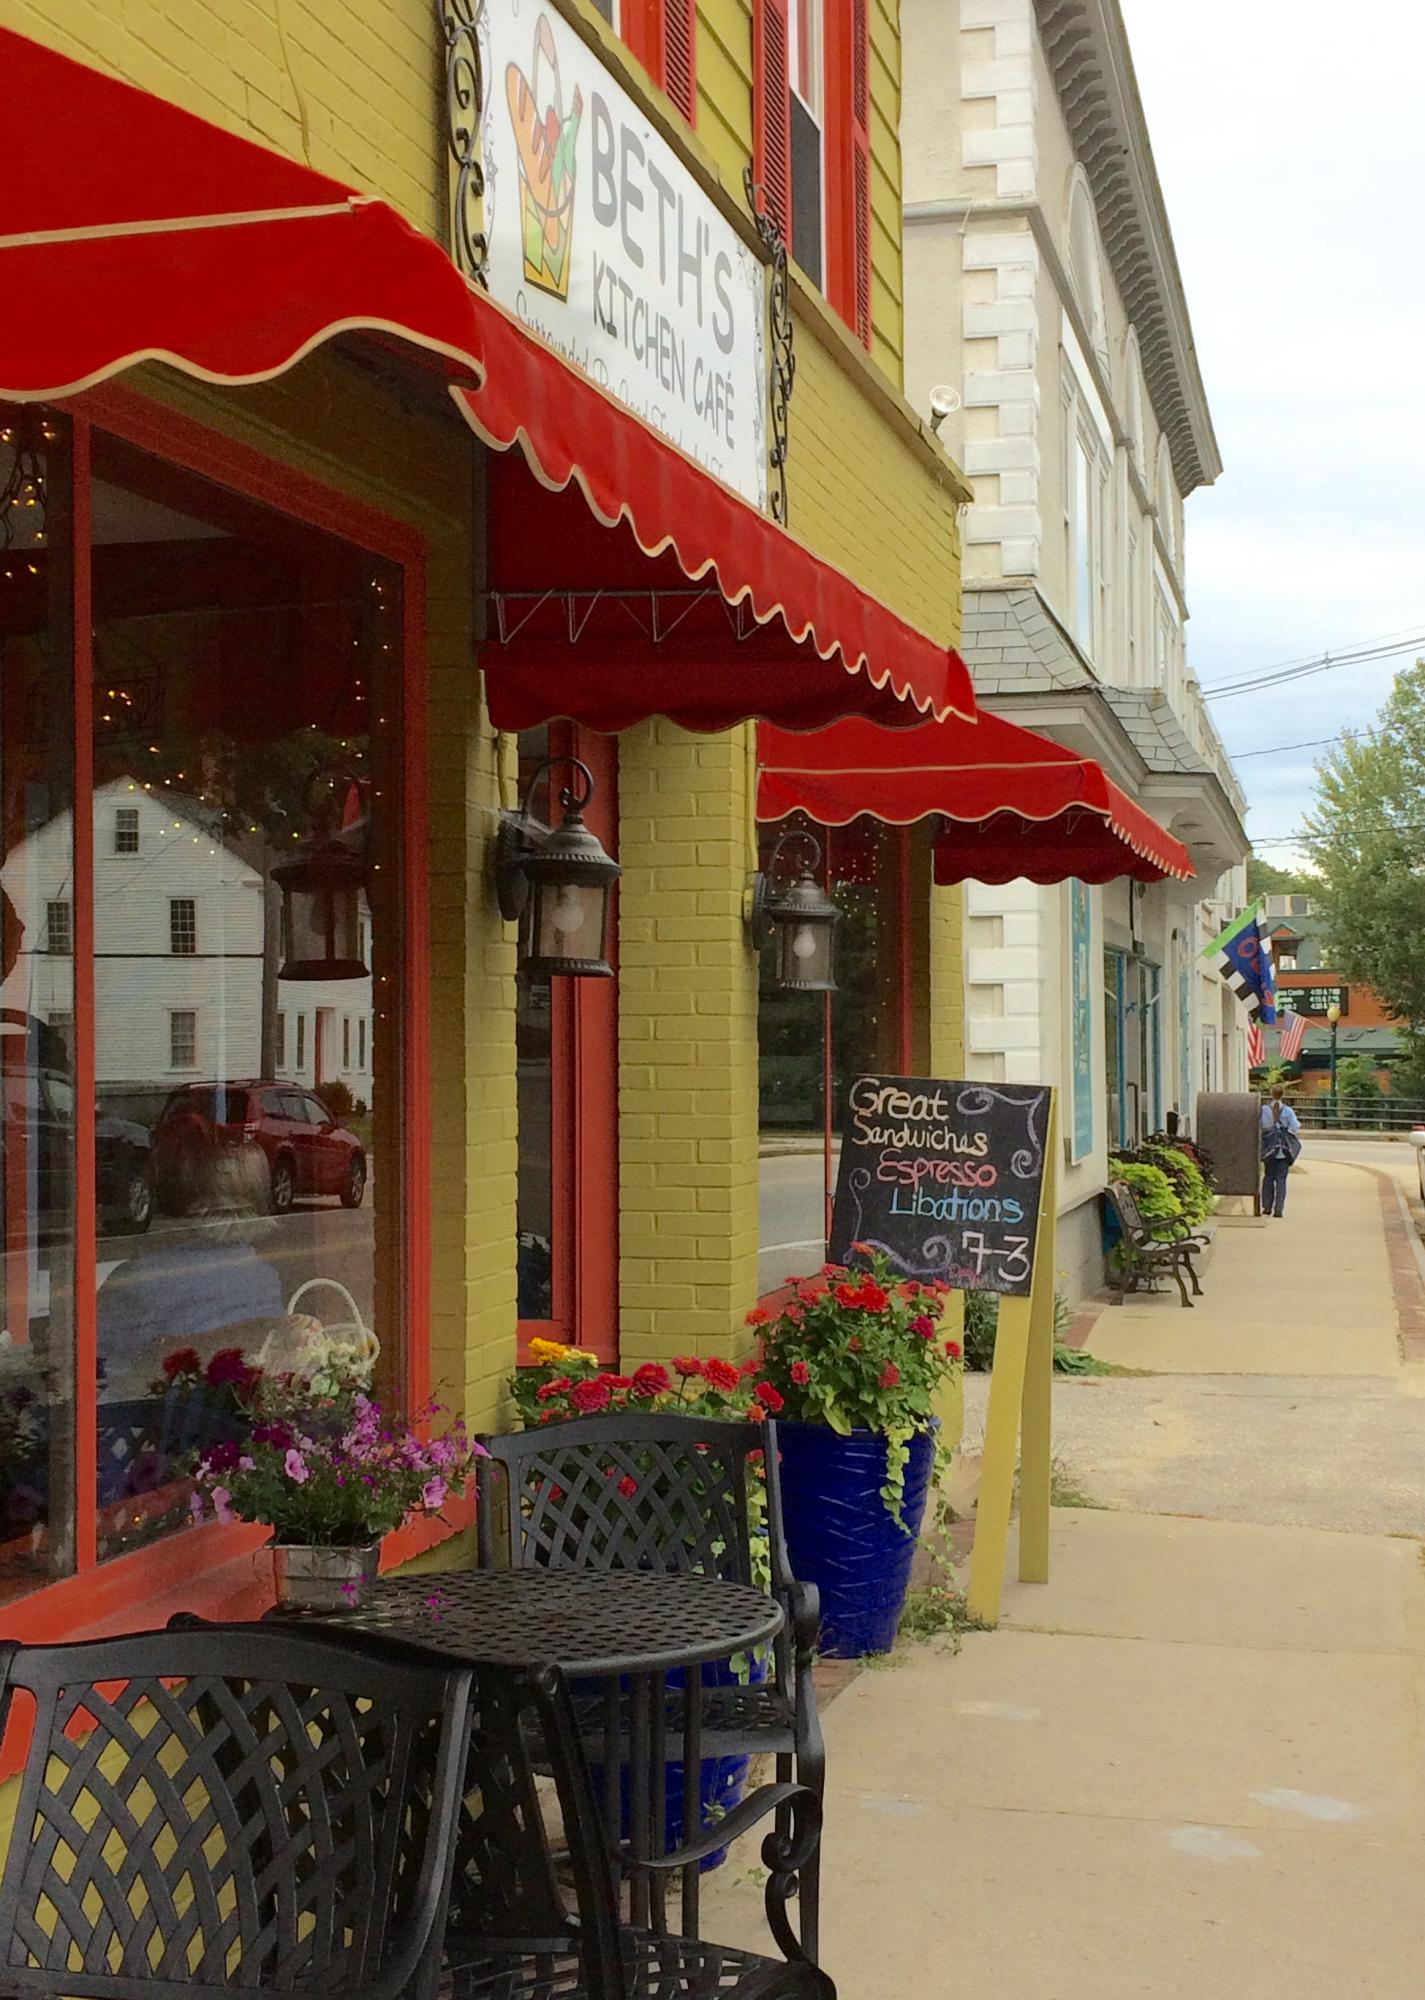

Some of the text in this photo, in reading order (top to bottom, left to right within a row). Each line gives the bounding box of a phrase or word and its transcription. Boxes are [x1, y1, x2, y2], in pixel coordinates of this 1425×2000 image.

[591, 91, 735, 355] BETH'S
[592, 250, 686, 404] KITCHEN
[693, 356, 735, 450] CAFÉ
[850, 1078, 950, 1122] Great
[876, 1148, 998, 1192] Espresso
[889, 1186, 1024, 1224] Libations
